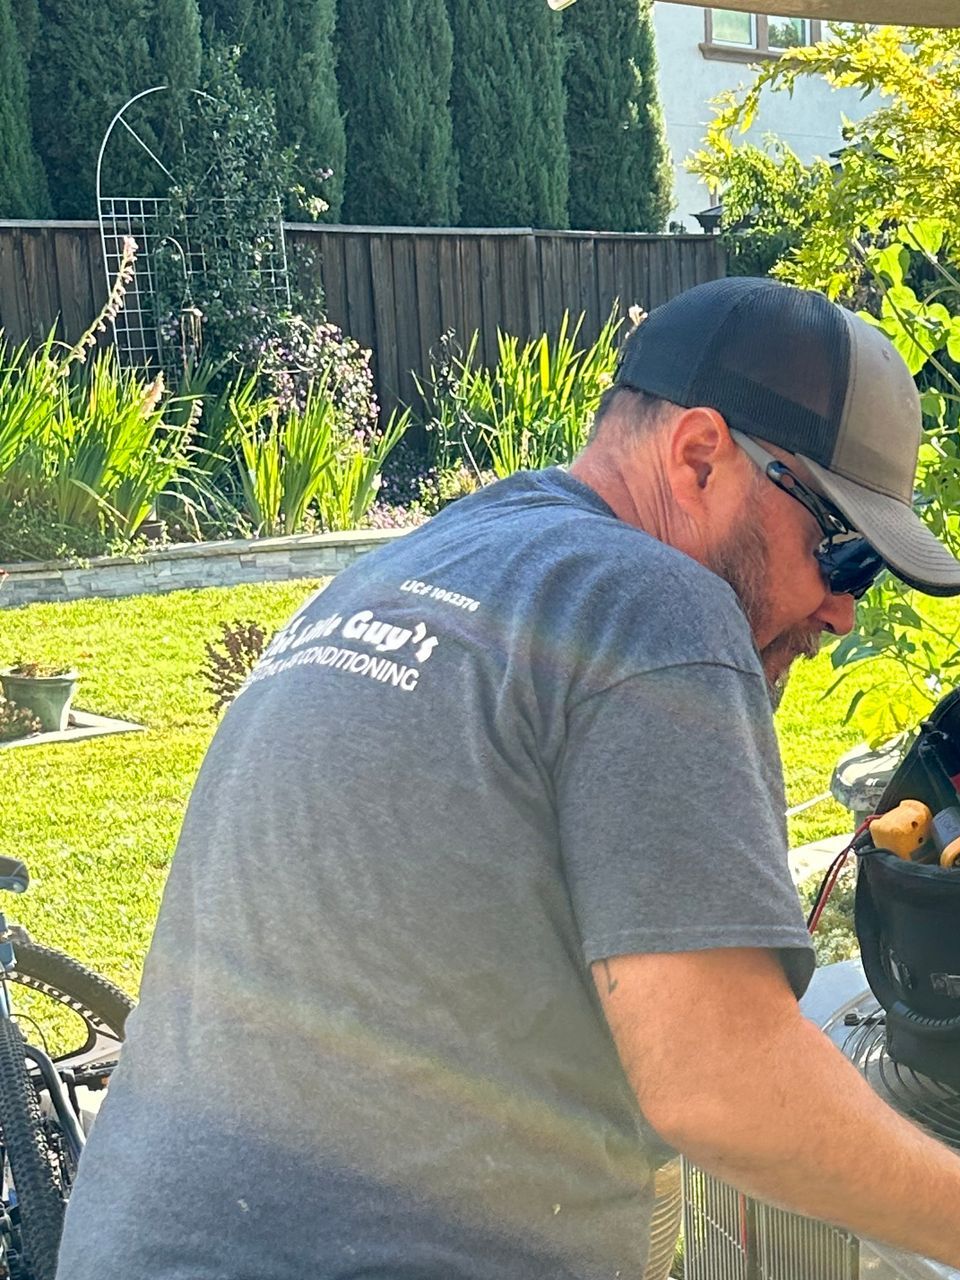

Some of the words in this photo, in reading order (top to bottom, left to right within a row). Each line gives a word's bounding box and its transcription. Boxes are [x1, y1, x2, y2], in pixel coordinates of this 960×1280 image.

[400, 579, 433, 596] LIC#
[342, 610, 439, 663] Guy's
[299, 646, 420, 691] CONDITIONING
